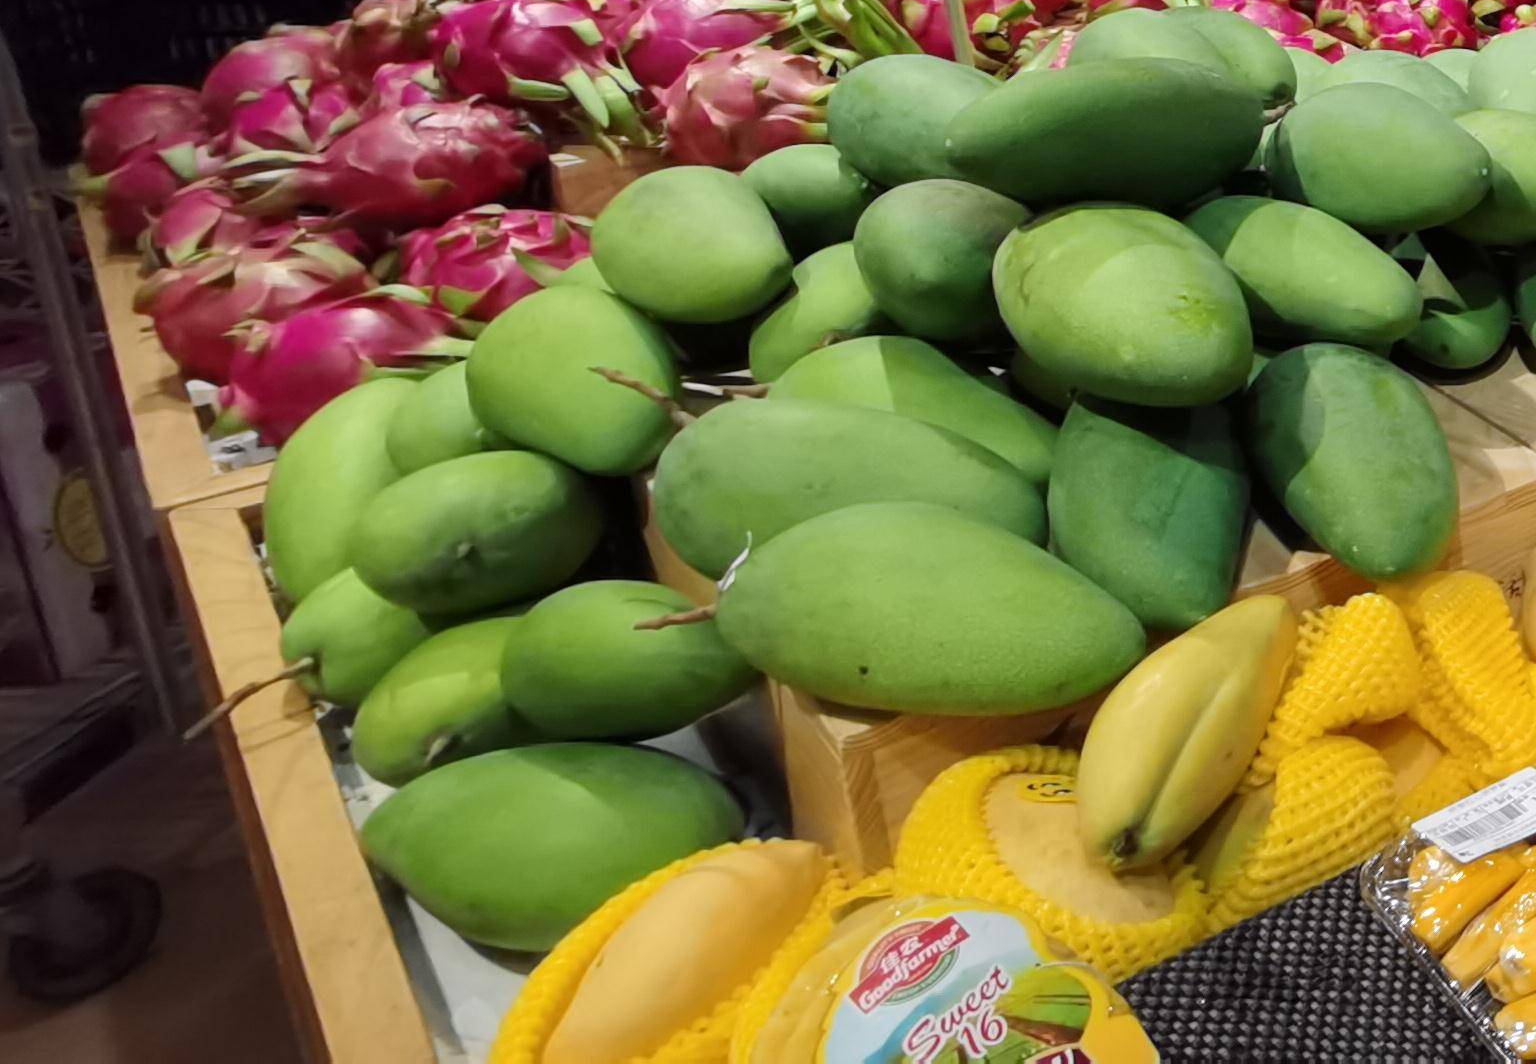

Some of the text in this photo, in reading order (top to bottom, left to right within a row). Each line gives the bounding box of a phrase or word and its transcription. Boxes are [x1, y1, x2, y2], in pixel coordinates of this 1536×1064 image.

[858, 922, 961, 1010] Goodfarmer
[880, 934, 923, 974] 佳农
[904, 965, 1011, 1064] Sweet
[961, 1011, 1006, 1060] 16
